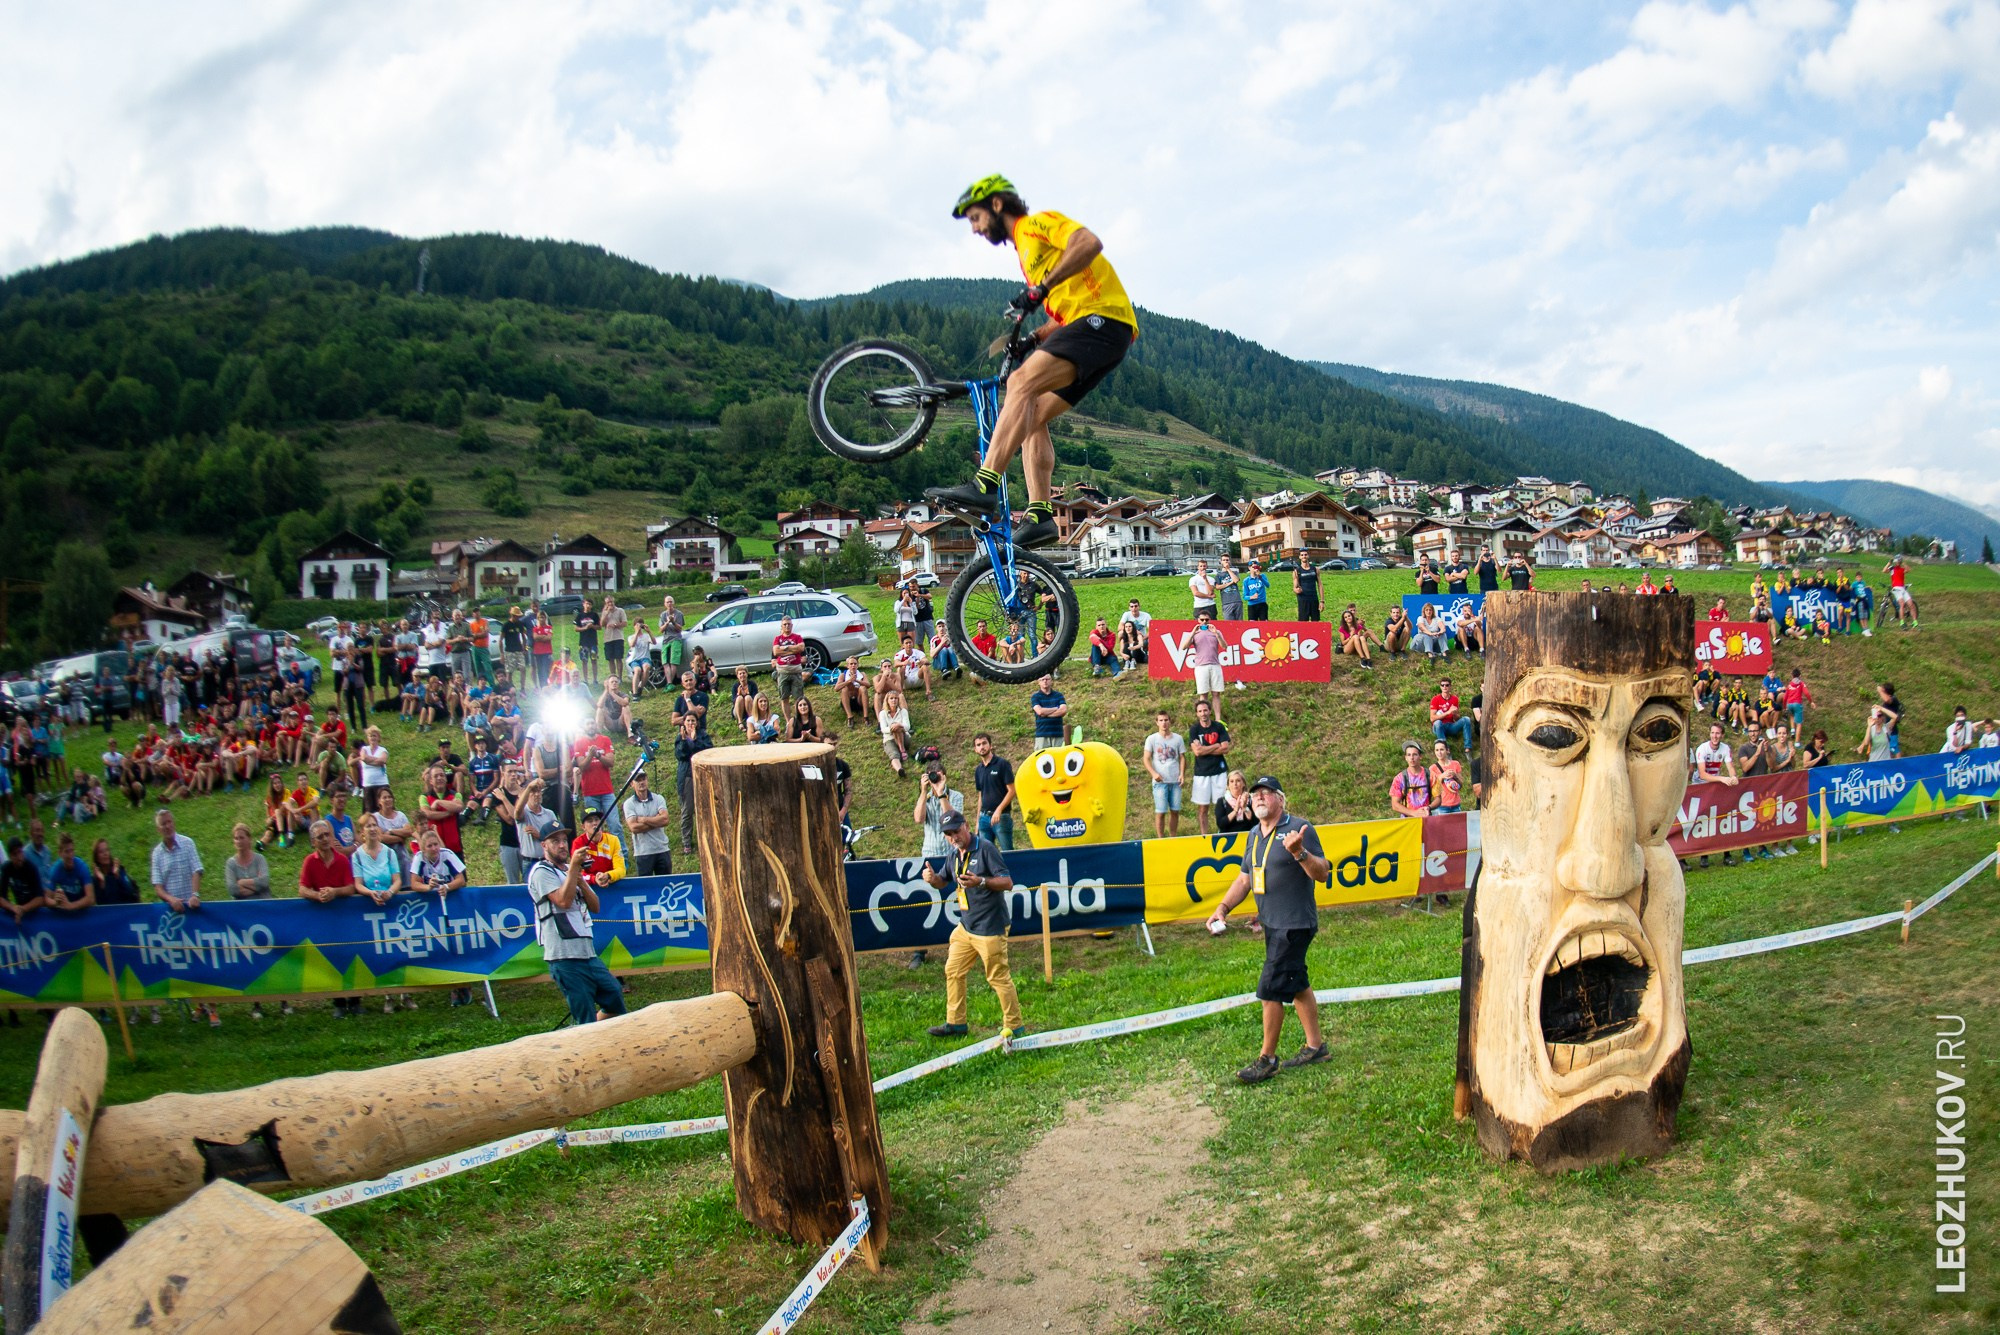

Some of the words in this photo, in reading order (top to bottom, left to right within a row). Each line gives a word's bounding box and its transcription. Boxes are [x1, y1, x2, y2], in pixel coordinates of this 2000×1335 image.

[1218, 645, 1241, 666] di
[1832, 773, 1905, 806] TRENTINO
[1944, 760, 2000, 789] TRENTIN
[1046, 820, 1086, 834] Melinda
[1677, 797, 1718, 843] Val
[1720, 809, 1738, 835] di
[1738, 791, 1798, 833] Sole
[363, 907, 527, 959] TRENTINO
[623, 895, 708, 939] TREN
[0, 931, 58, 975] TINO
[129, 923, 275, 970] TRENTINO
[782, 1284, 813, 1327] TRENTINO
